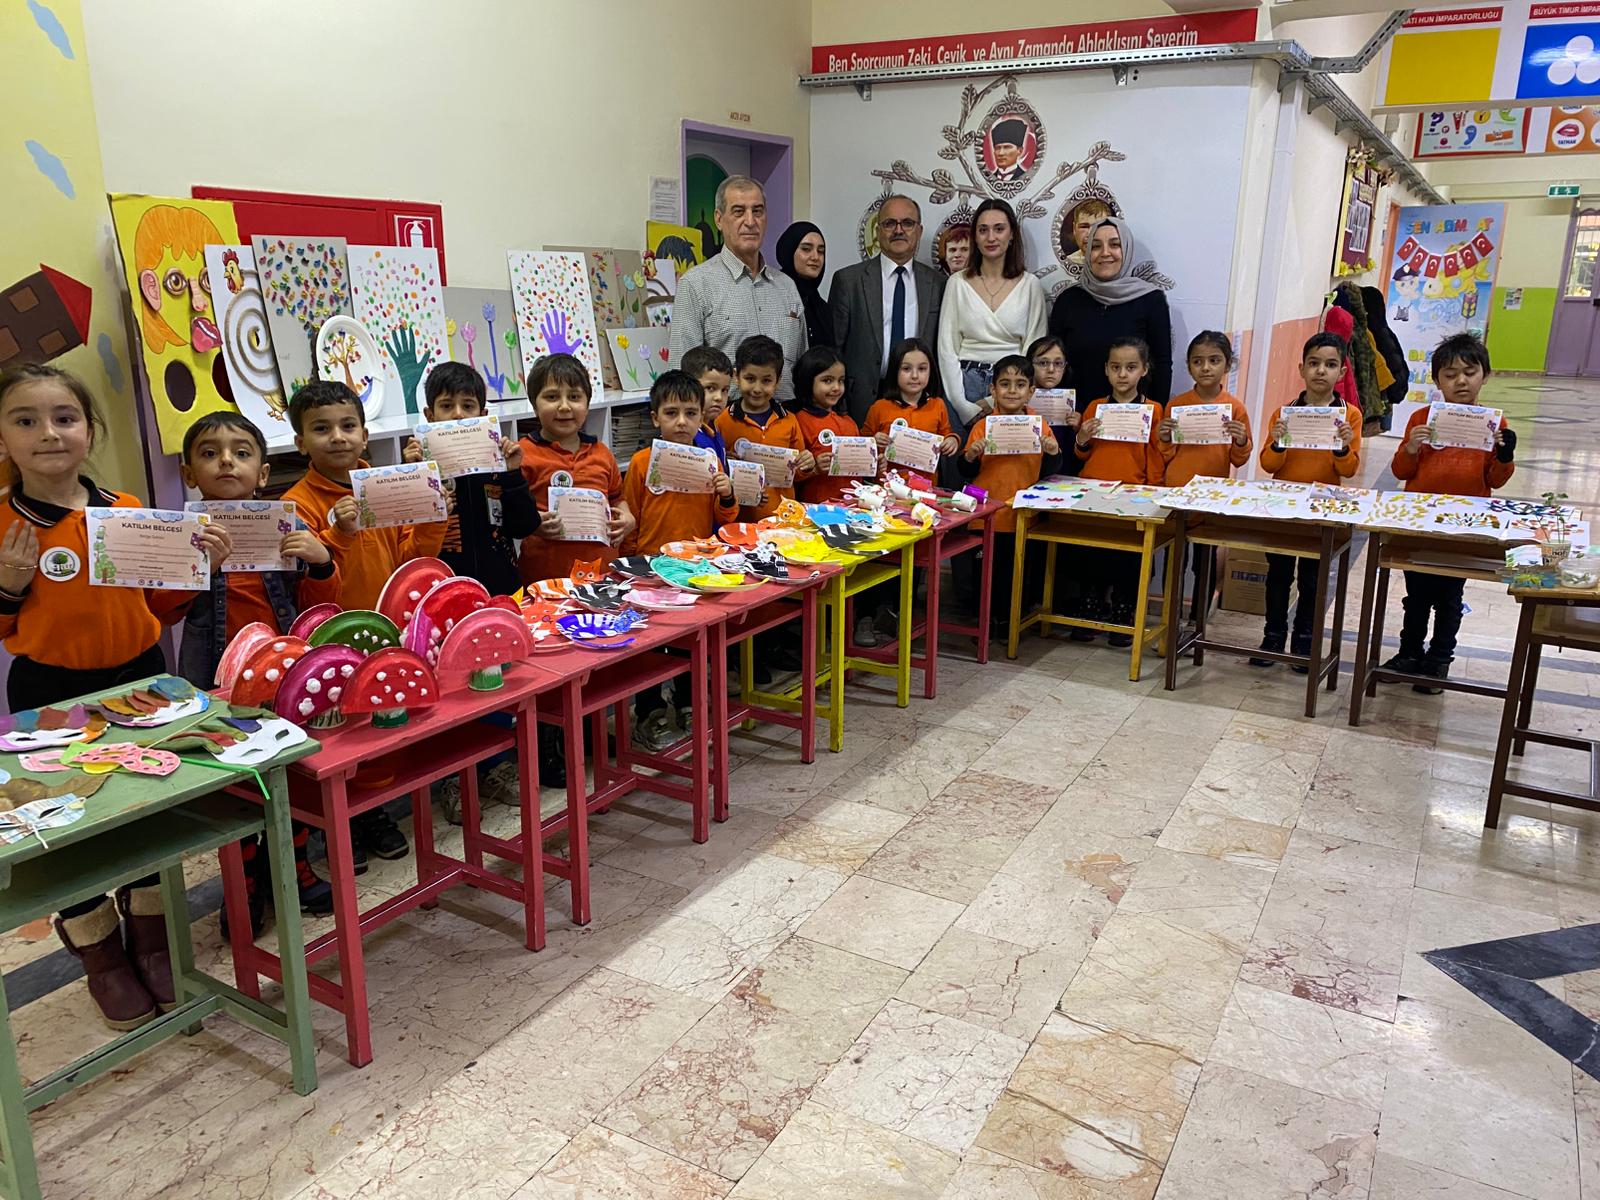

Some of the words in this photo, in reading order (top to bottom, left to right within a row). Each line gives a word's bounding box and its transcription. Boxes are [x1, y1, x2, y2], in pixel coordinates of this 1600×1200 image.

[1419, 15, 1435, 24] HUN
[1435, 11, 1499, 23] İMPARATORLUĞU
[828, 53, 848, 73] Ben
[973, 48, 986, 62] ve
[1017, 34, 1074, 58] Zamanda
[1146, 25, 1199, 48] Severim
[121, 522, 152, 530] KATILIM
[153, 525, 183, 533] BELGESİ
